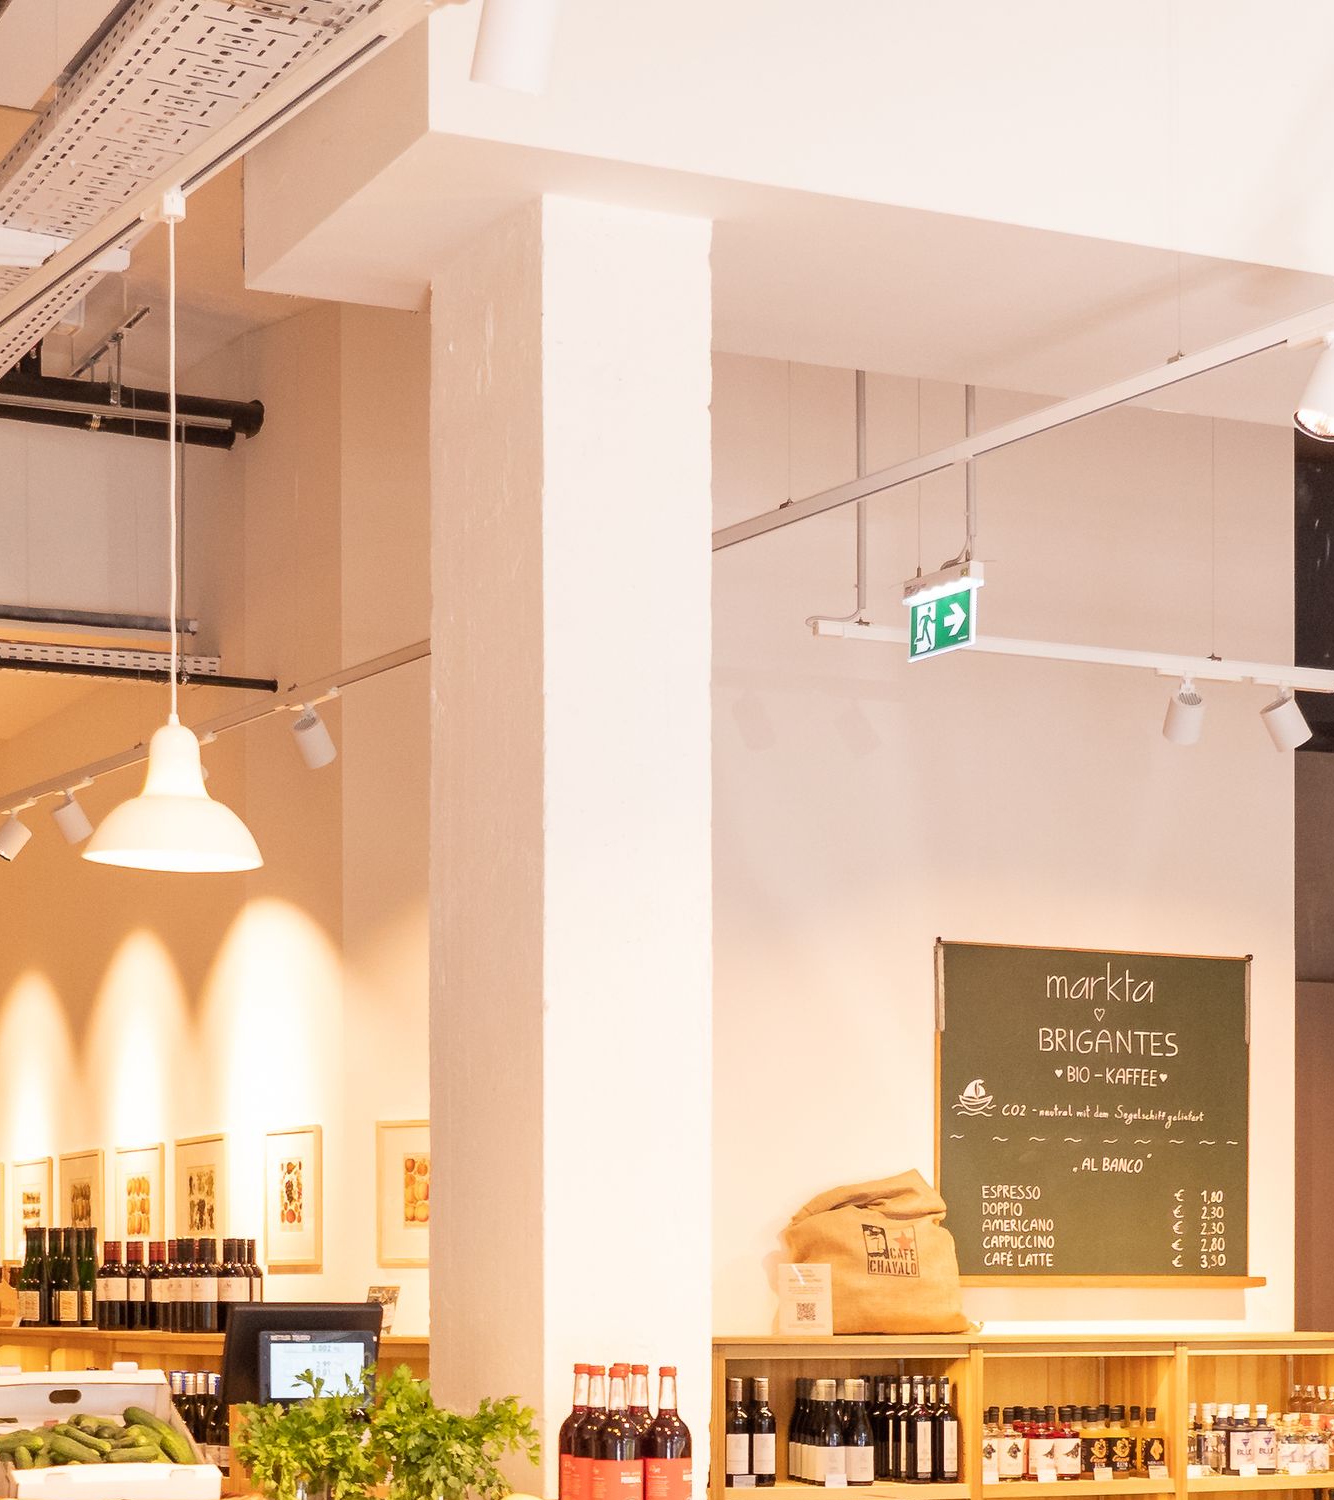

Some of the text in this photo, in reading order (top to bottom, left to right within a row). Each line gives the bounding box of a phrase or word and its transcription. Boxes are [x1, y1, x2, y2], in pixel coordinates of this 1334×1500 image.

[1046, 962, 1154, 1003] markta
[1038, 1028, 1179, 1057] BRIGANTES
[1001, 1104, 1026, 1117] CO2
[1076, 1106, 1091, 1118] mit
[1094, 1106, 1109, 1118] dem
[982, 1185, 1224, 1204] ESPRESSO € 1,80
[982, 1202, 1224, 1220] DOPPIO € 2,30
[982, 1219, 1225, 1236] AMERICANO € 2,30
[982, 1235, 1226, 1253] CAPPUCCINO € 2,80
[984, 1250, 1013, 1267] CAFÉ
[1018, 1253, 1054, 1267] LATTE
[1171, 1254, 1183, 1268] €
